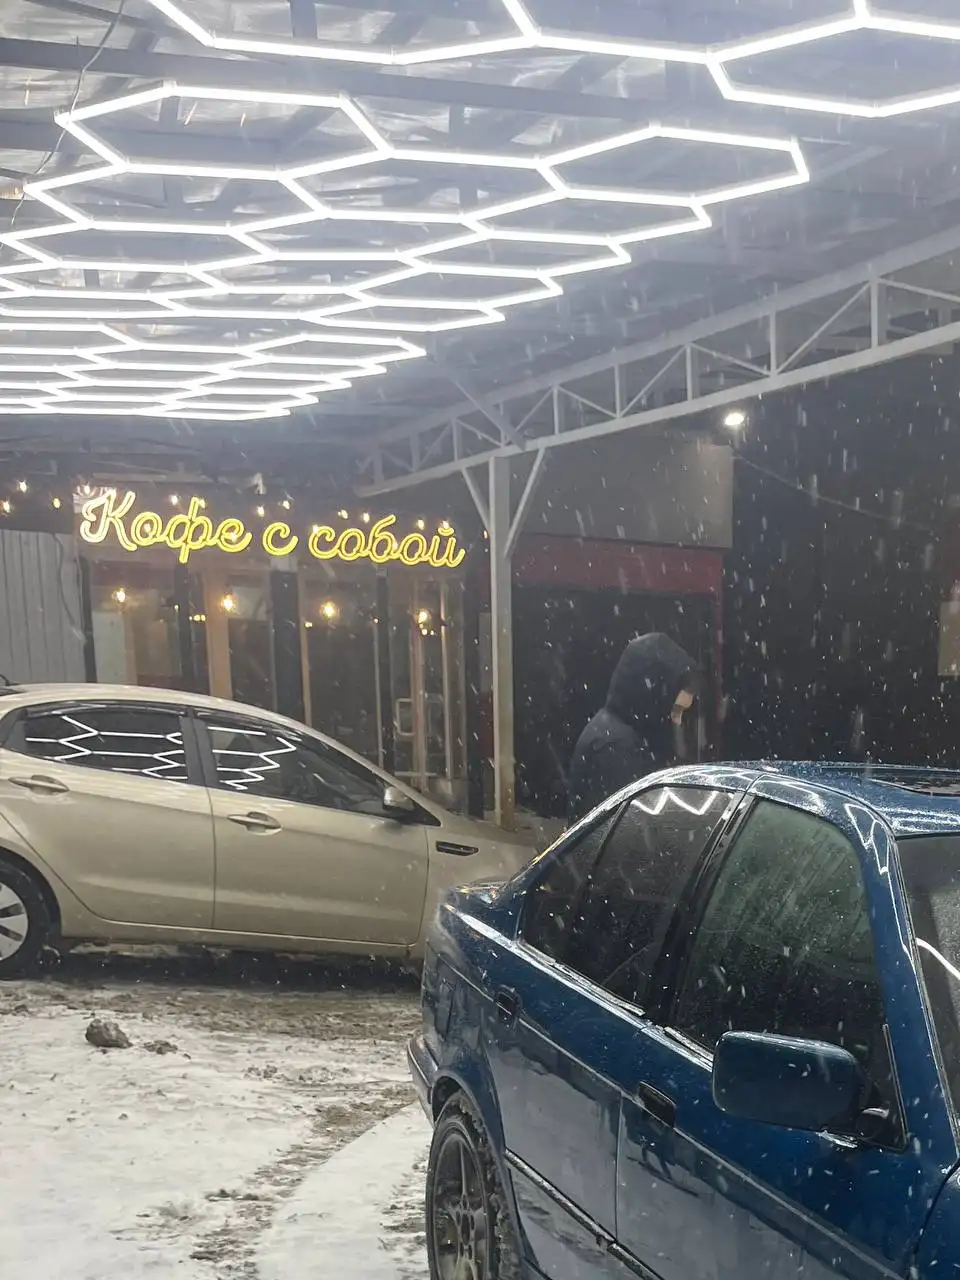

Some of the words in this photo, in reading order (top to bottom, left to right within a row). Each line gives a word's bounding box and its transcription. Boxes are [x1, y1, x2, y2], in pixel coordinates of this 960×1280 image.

[80, 489, 253, 564] Кофе
[262, 522, 299, 556] с
[308, 514, 466, 568] собой
